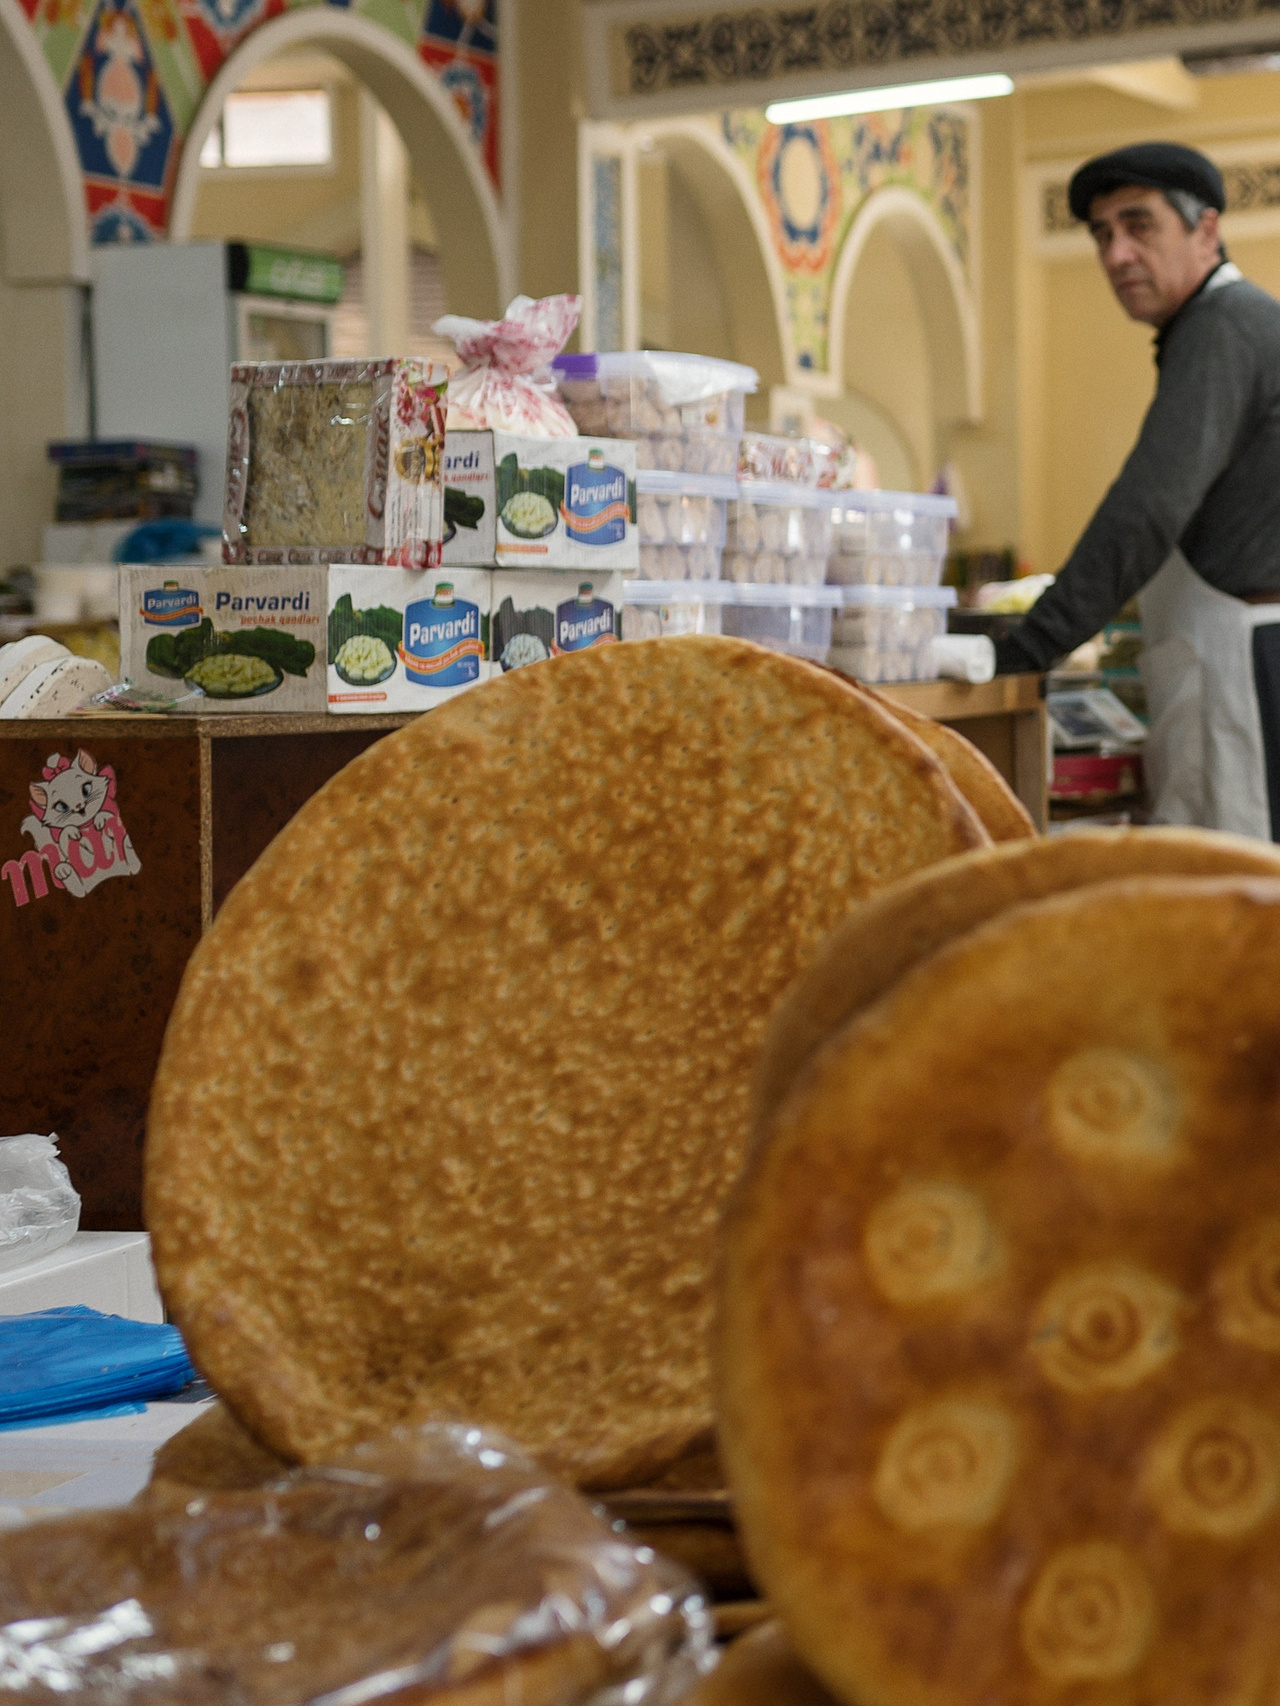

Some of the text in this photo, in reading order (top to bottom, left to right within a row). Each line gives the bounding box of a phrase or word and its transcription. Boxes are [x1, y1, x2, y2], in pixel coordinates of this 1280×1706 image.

[570, 475, 623, 507] Parvardi
[147, 593, 197, 610] Parvardi
[215, 591, 310, 611] Parvardi
[409, 610, 476, 648] Parvardi
[559, 608, 611, 644] Parvardi
